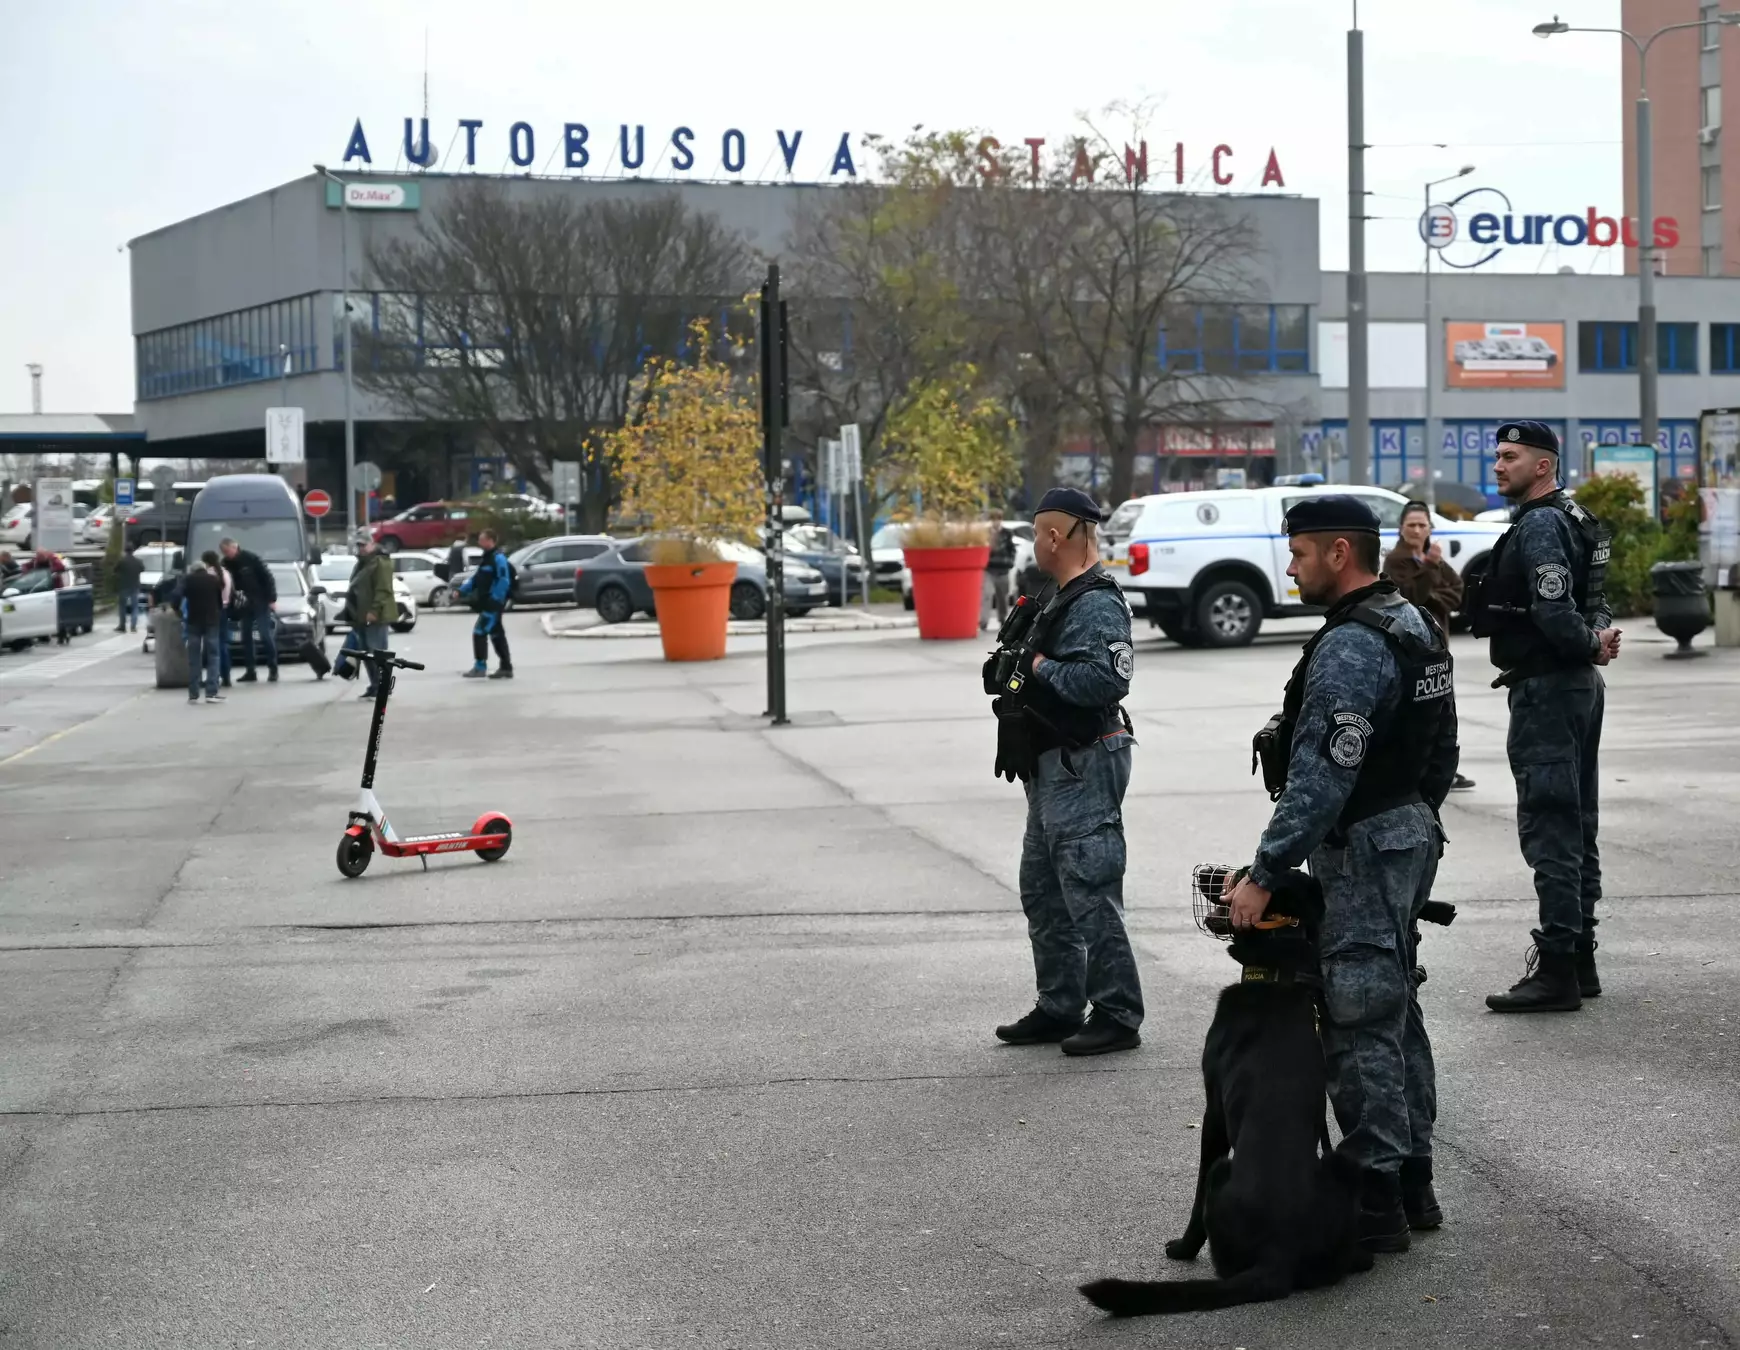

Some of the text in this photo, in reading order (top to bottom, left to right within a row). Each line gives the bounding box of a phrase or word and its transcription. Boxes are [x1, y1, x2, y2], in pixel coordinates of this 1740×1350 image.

[976, 136, 1285, 187] STANICA
[350, 189, 391, 201] Dr.Max
[1468, 206, 1680, 249] eurobus
[1415, 672, 1452, 697] POLÍCIA
